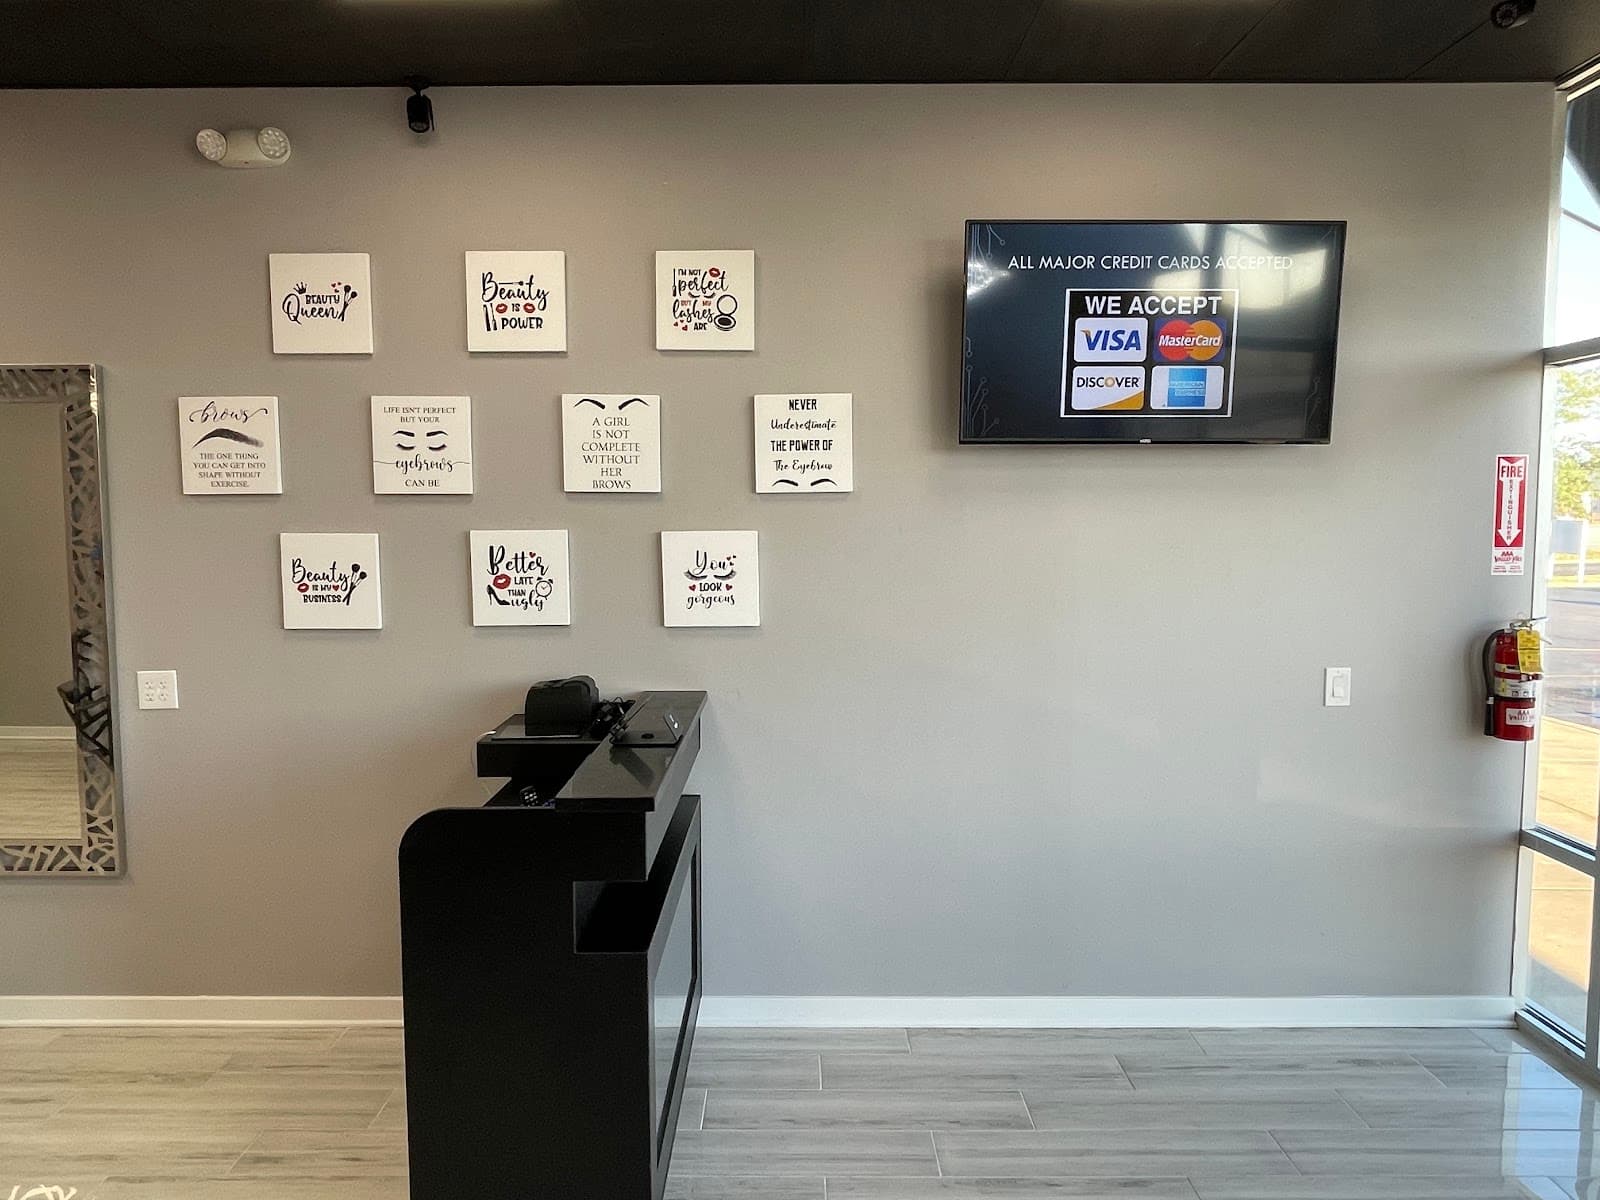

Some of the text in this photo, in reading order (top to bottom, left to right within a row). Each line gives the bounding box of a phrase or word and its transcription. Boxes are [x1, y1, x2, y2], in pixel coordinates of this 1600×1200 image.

[1008, 255, 1293, 270] ALL MAJOR CREDIT CARDS ACCEPTED
[679, 271, 729, 296] perfect
[482, 272, 550, 311] Beauty
[305, 295, 340, 304] BEAUTY
[1085, 295, 1222, 316] WE ACCEPT
[282, 293, 338, 325] Queen
[512, 303, 520, 312] IS
[673, 299, 714, 323] lashes
[501, 317, 543, 329] POWER
[1080, 329, 1142, 351] VISA
[1158, 335, 1221, 347] MasterCard
[1077, 377, 1139, 388] DISCOVER
[789, 399, 817, 410] NEVER
[189, 401, 268, 423] brows
[592, 417, 631, 426] A GIRL
[771, 418, 837, 430] Underestimate
[592, 430, 630, 439] IS NOT
[582, 442, 640, 451] COMPLETE
[771, 440, 833, 451] THE POWER OF
[396, 454, 453, 475] eyebrows
[583, 455, 640, 464] WITHOUT
[601, 468, 622, 476] HER
[772, 460, 832, 474] The Eyebrow
[1501, 466, 1523, 478] FIRE
[593, 480, 631, 489] BROWS
[487, 545, 550, 576] Better
[693, 550, 726, 575] You
[292, 558, 349, 592] Beauty
[514, 577, 534, 585] LATE
[699, 582, 722, 591] LOOK
[303, 595, 341, 603] BUSINESS
[511, 590, 543, 611] ugly
[686, 595, 735, 609] gorgeous
